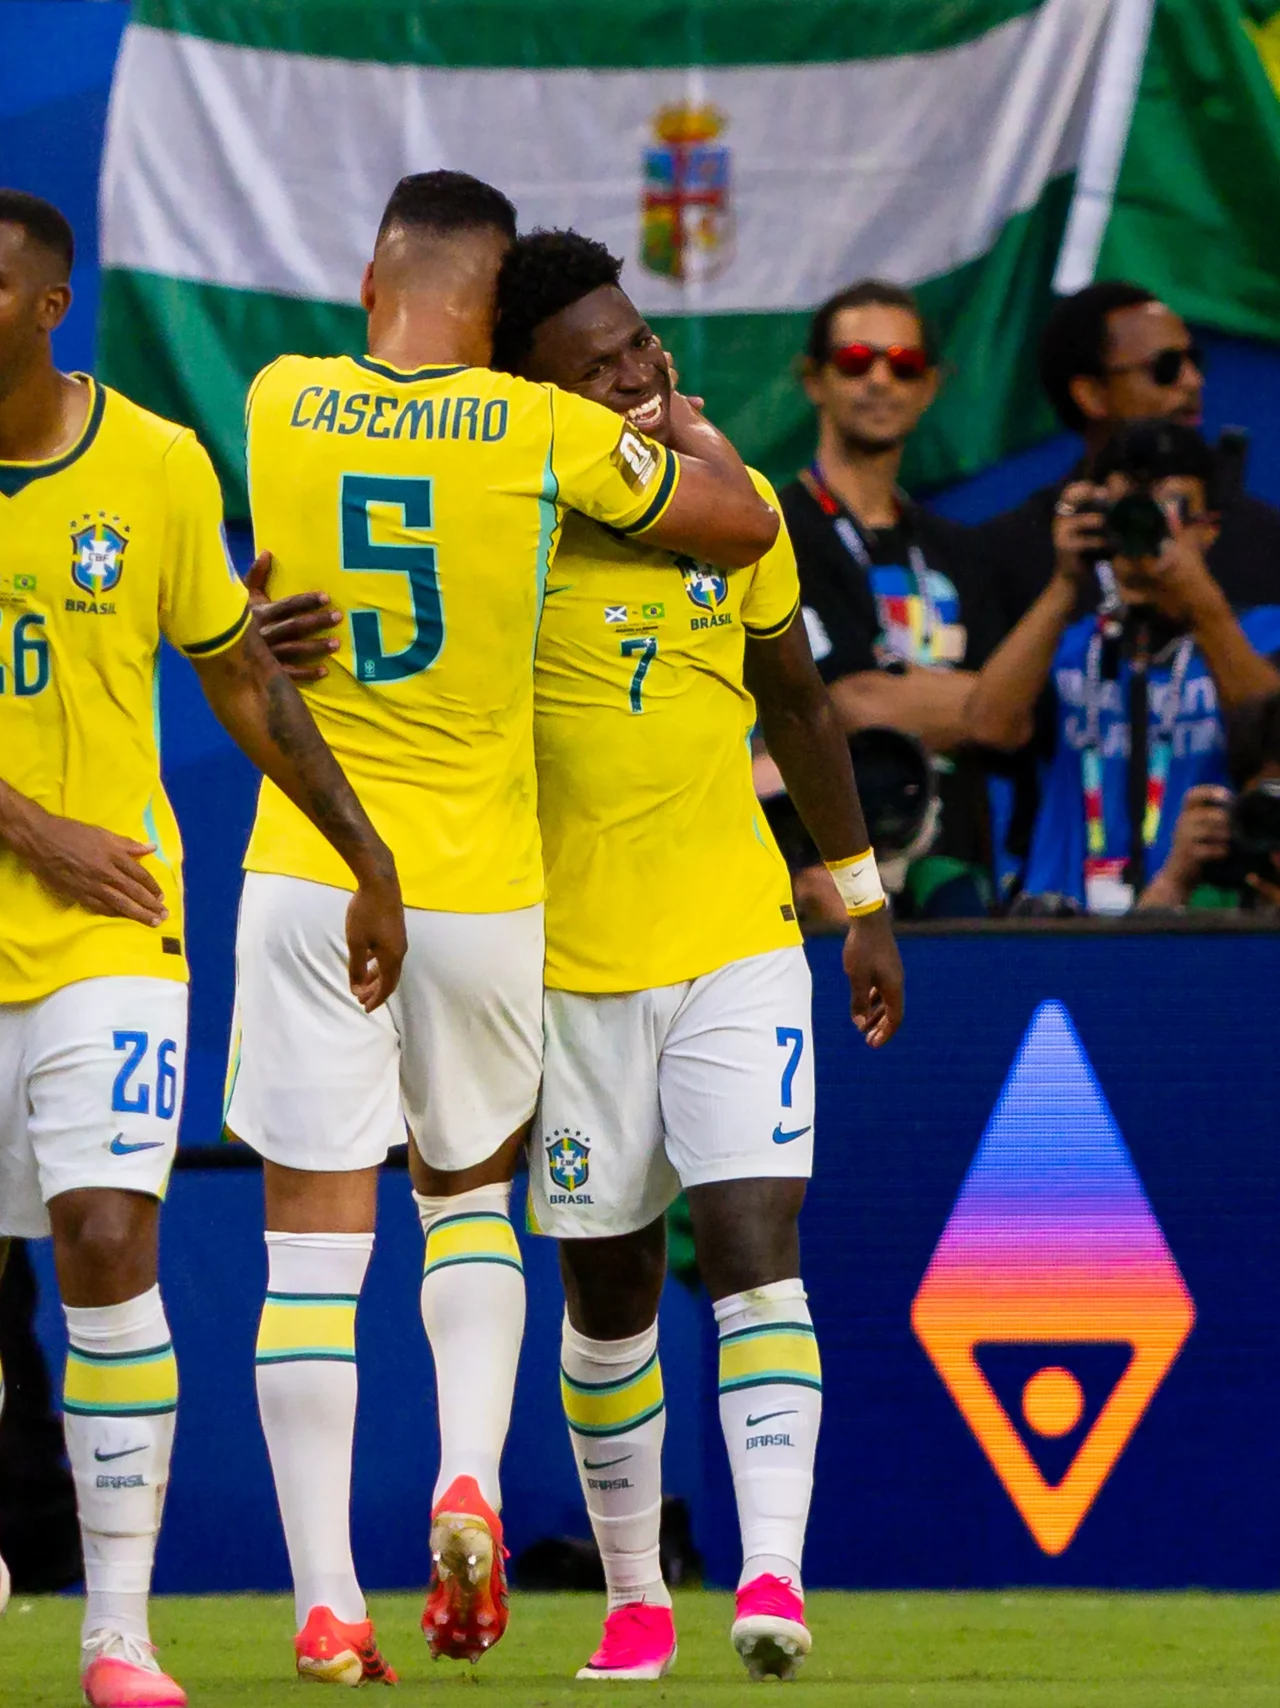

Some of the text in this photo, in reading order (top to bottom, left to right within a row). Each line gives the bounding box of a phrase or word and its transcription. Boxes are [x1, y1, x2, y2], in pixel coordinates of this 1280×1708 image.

[291, 386, 509, 442] CASEMIRO
[339, 472, 446, 684] 5
[65, 599, 117, 615] BRASIL
[690, 613, 733, 631] BRASIL
[620, 636, 658, 714] 7
[111, 1030, 177, 1120] 26
[775, 1026, 804, 1108] 7
[549, 1194, 595, 1205] BRASIL
[746, 1433, 795, 1450] BRASIL
